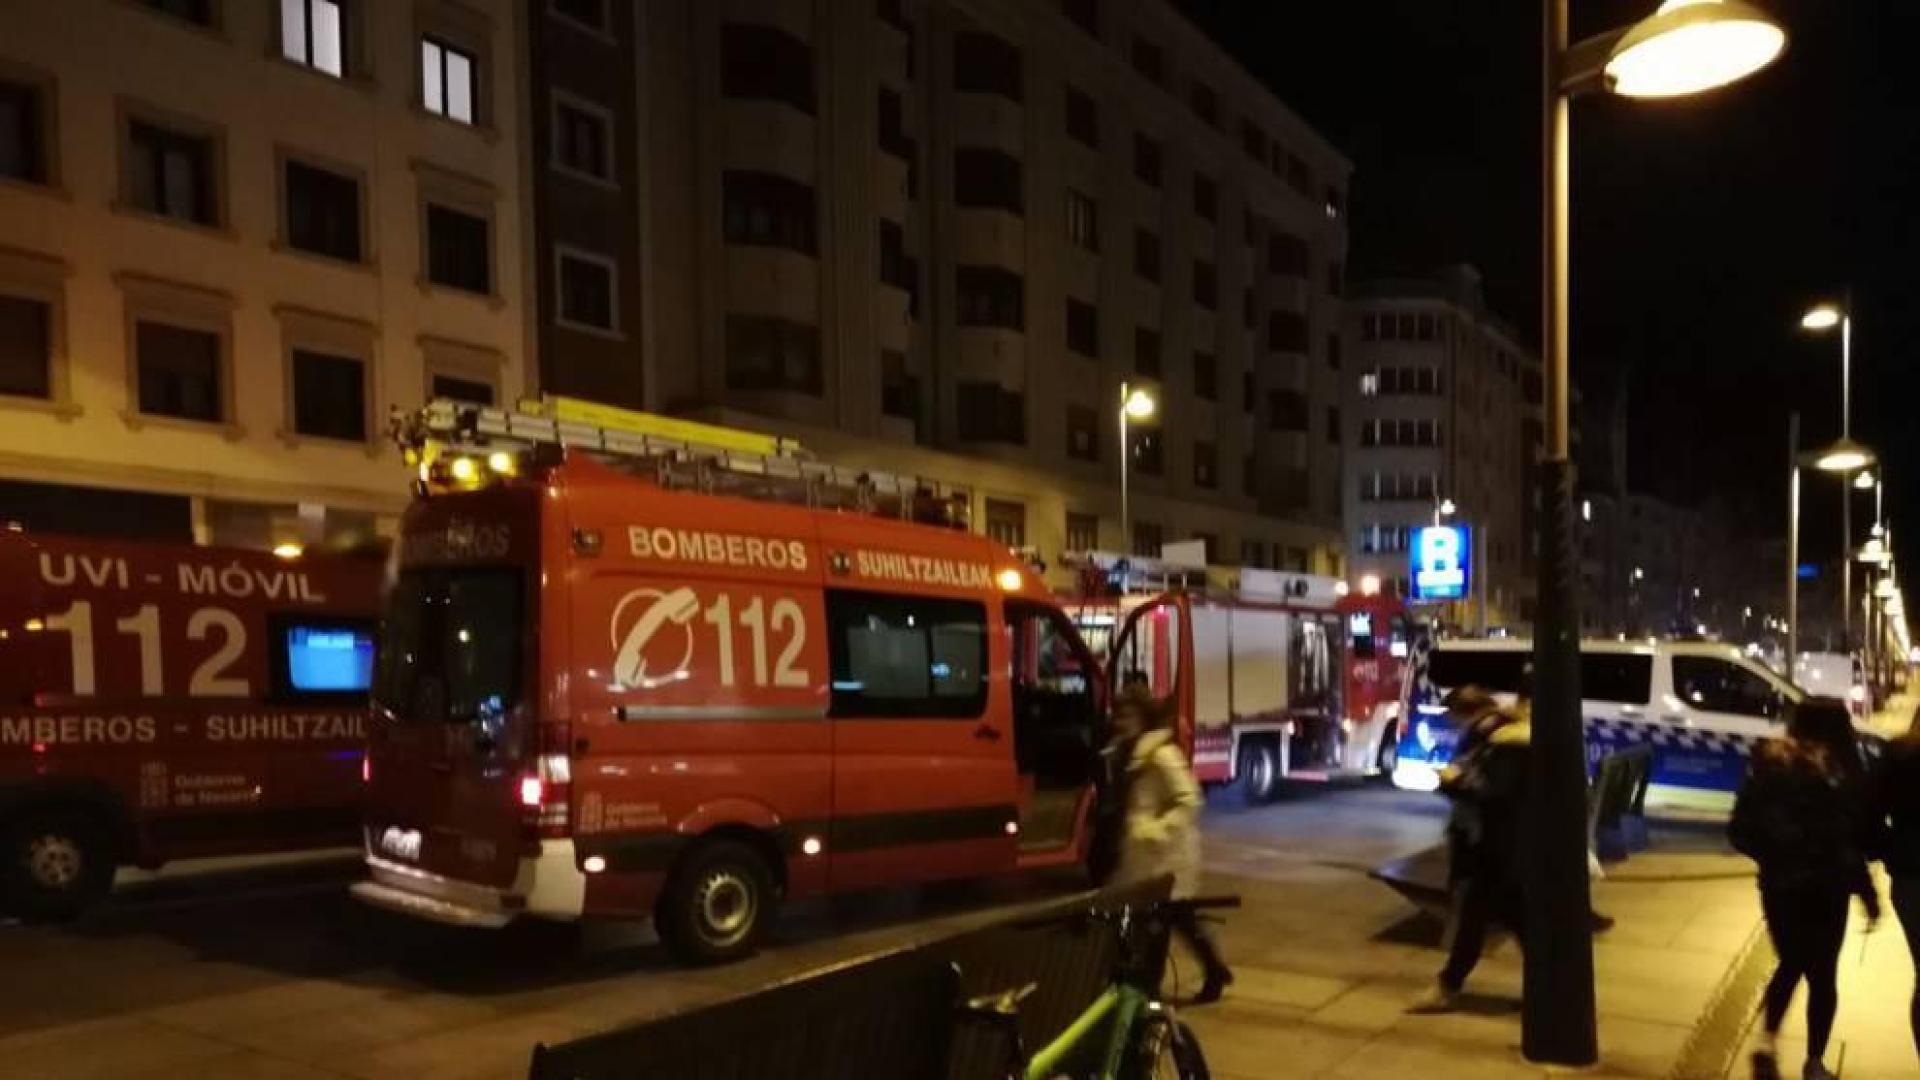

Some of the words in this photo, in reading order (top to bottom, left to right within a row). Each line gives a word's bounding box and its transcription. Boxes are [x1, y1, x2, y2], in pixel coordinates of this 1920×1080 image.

[628, 525, 808, 571] BOMBEROS
[857, 549, 991, 589] SUHILTZAILEAK
[40, 553, 129, 589] UVI
[177, 559, 327, 603] MÓVIL
[45, 600, 250, 697] 112
[705, 593, 810, 688] 112
[1, 714, 157, 744] MBEROS
